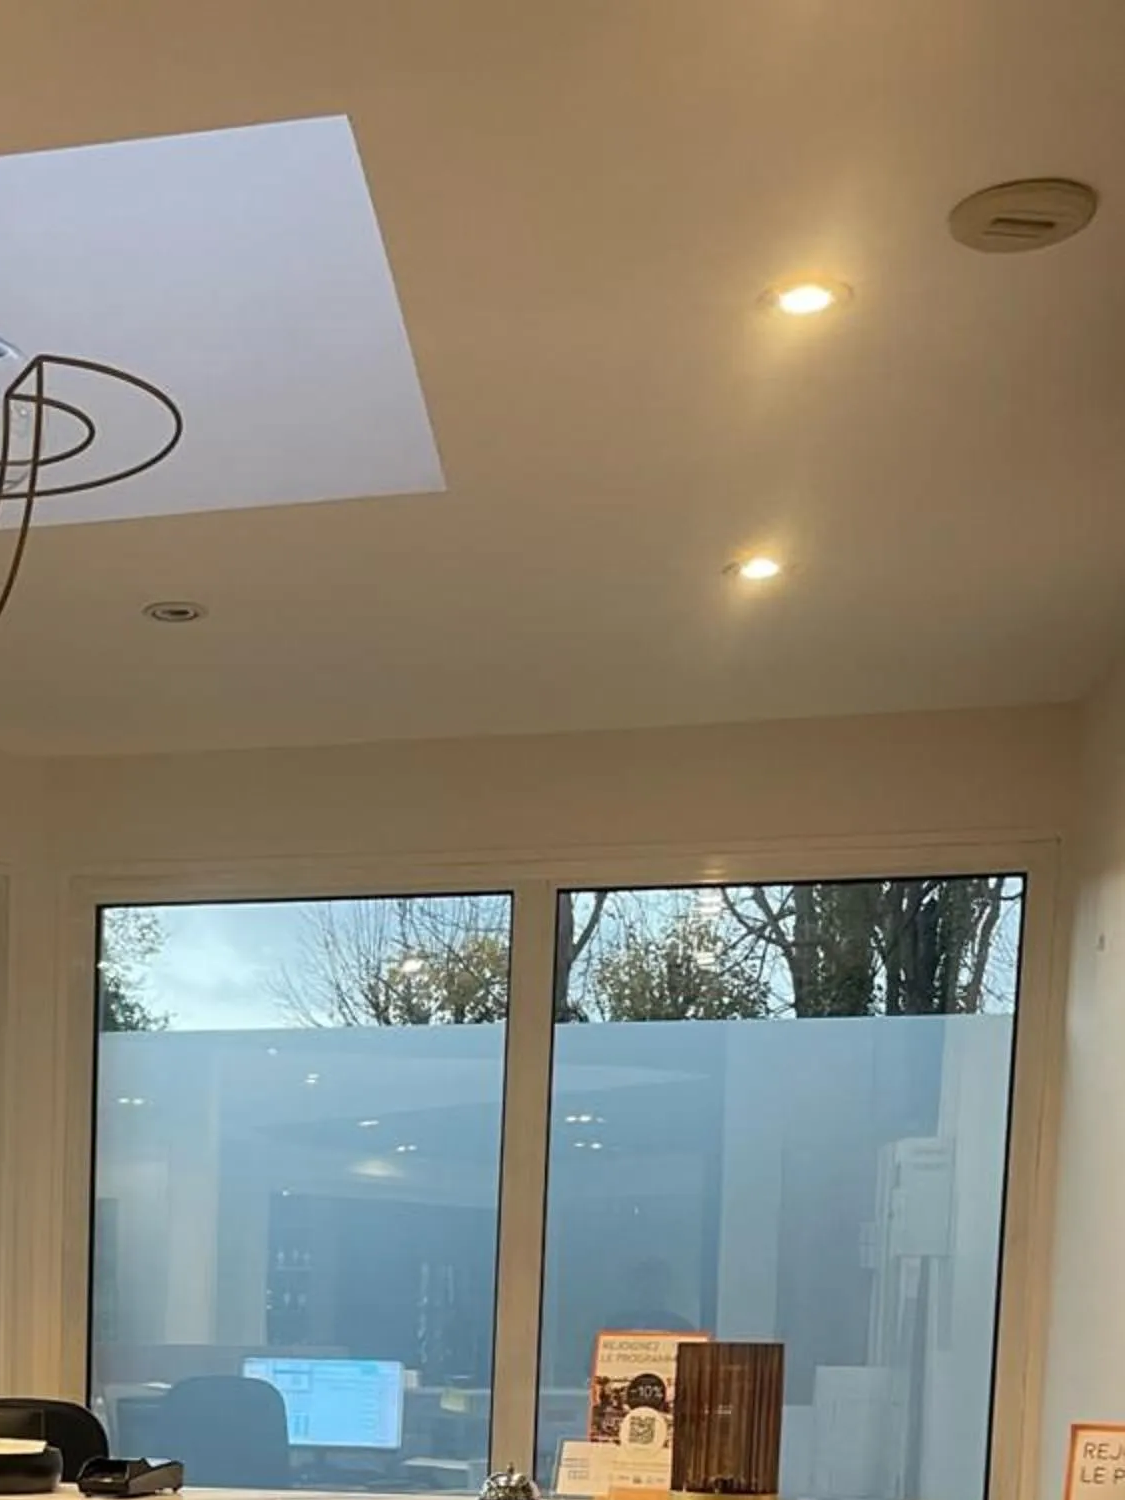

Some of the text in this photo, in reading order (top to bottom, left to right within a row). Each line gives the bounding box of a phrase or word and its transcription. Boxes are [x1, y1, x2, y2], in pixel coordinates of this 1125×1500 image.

[616, 1352, 677, 1363] PROGRAMM
[1083, 1442, 1125, 1460] REJ
[1080, 1466, 1106, 1485] LE
